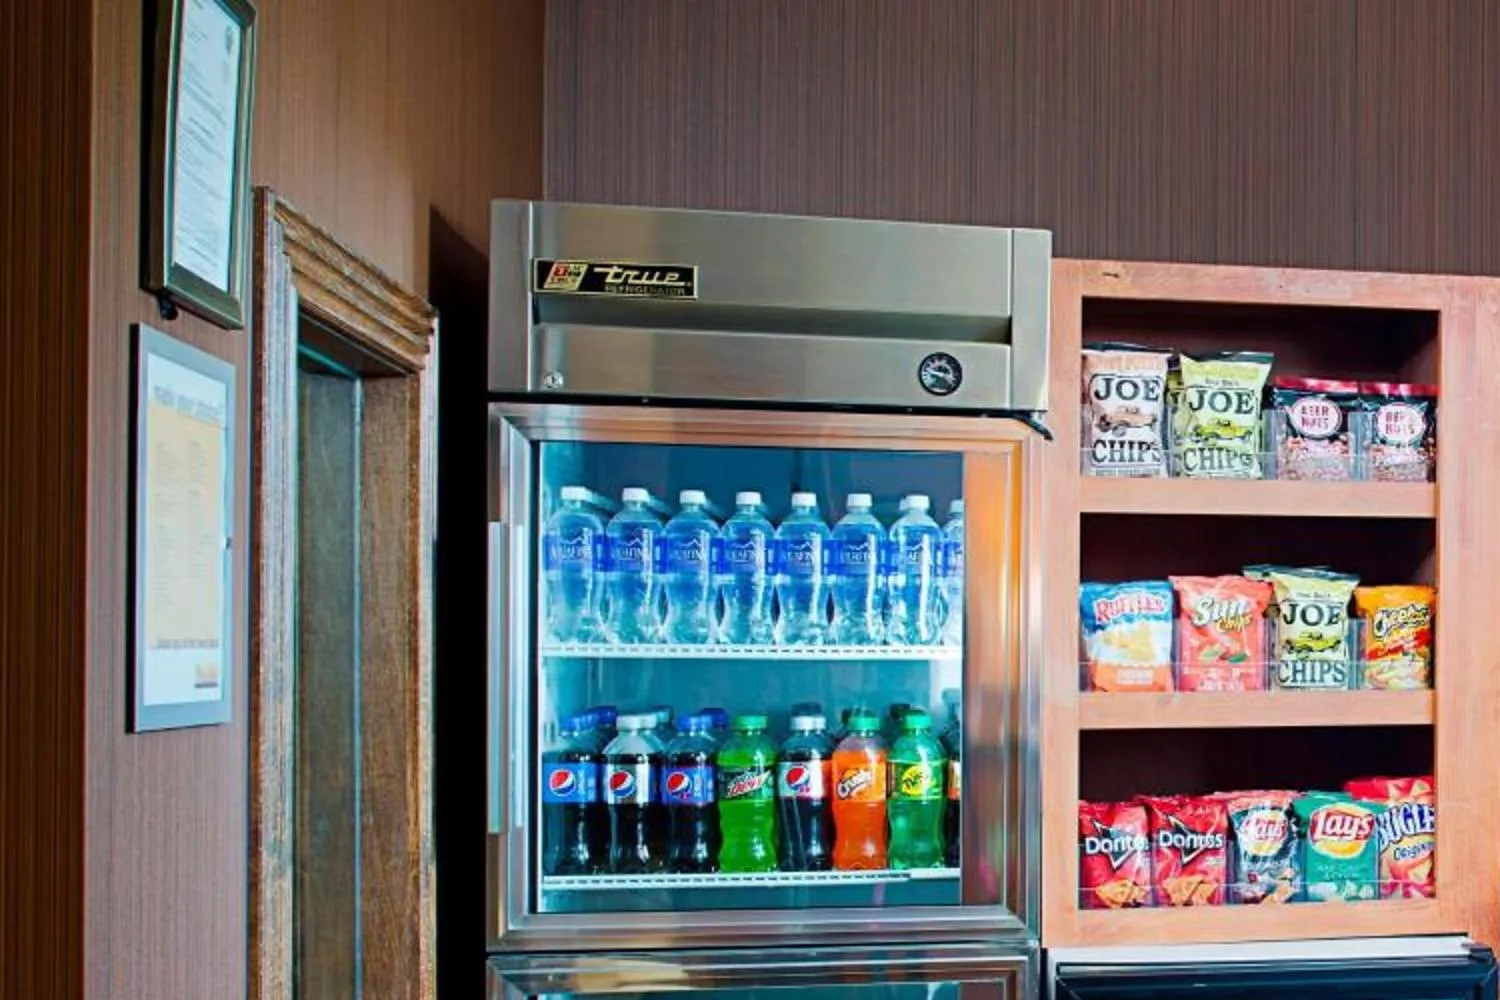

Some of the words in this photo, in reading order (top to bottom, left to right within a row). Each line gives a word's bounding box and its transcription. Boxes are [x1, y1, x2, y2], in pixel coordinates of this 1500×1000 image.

[593, 265, 686, 286] true
[1094, 376, 1160, 401] JOE
[1188, 390, 1254, 416] JOE
[1183, 447, 1253, 474] CHIPS
[1281, 603, 1344, 626] JOE
[1278, 659, 1346, 684] CHIPS
[1158, 830, 1223, 849] Doritos
